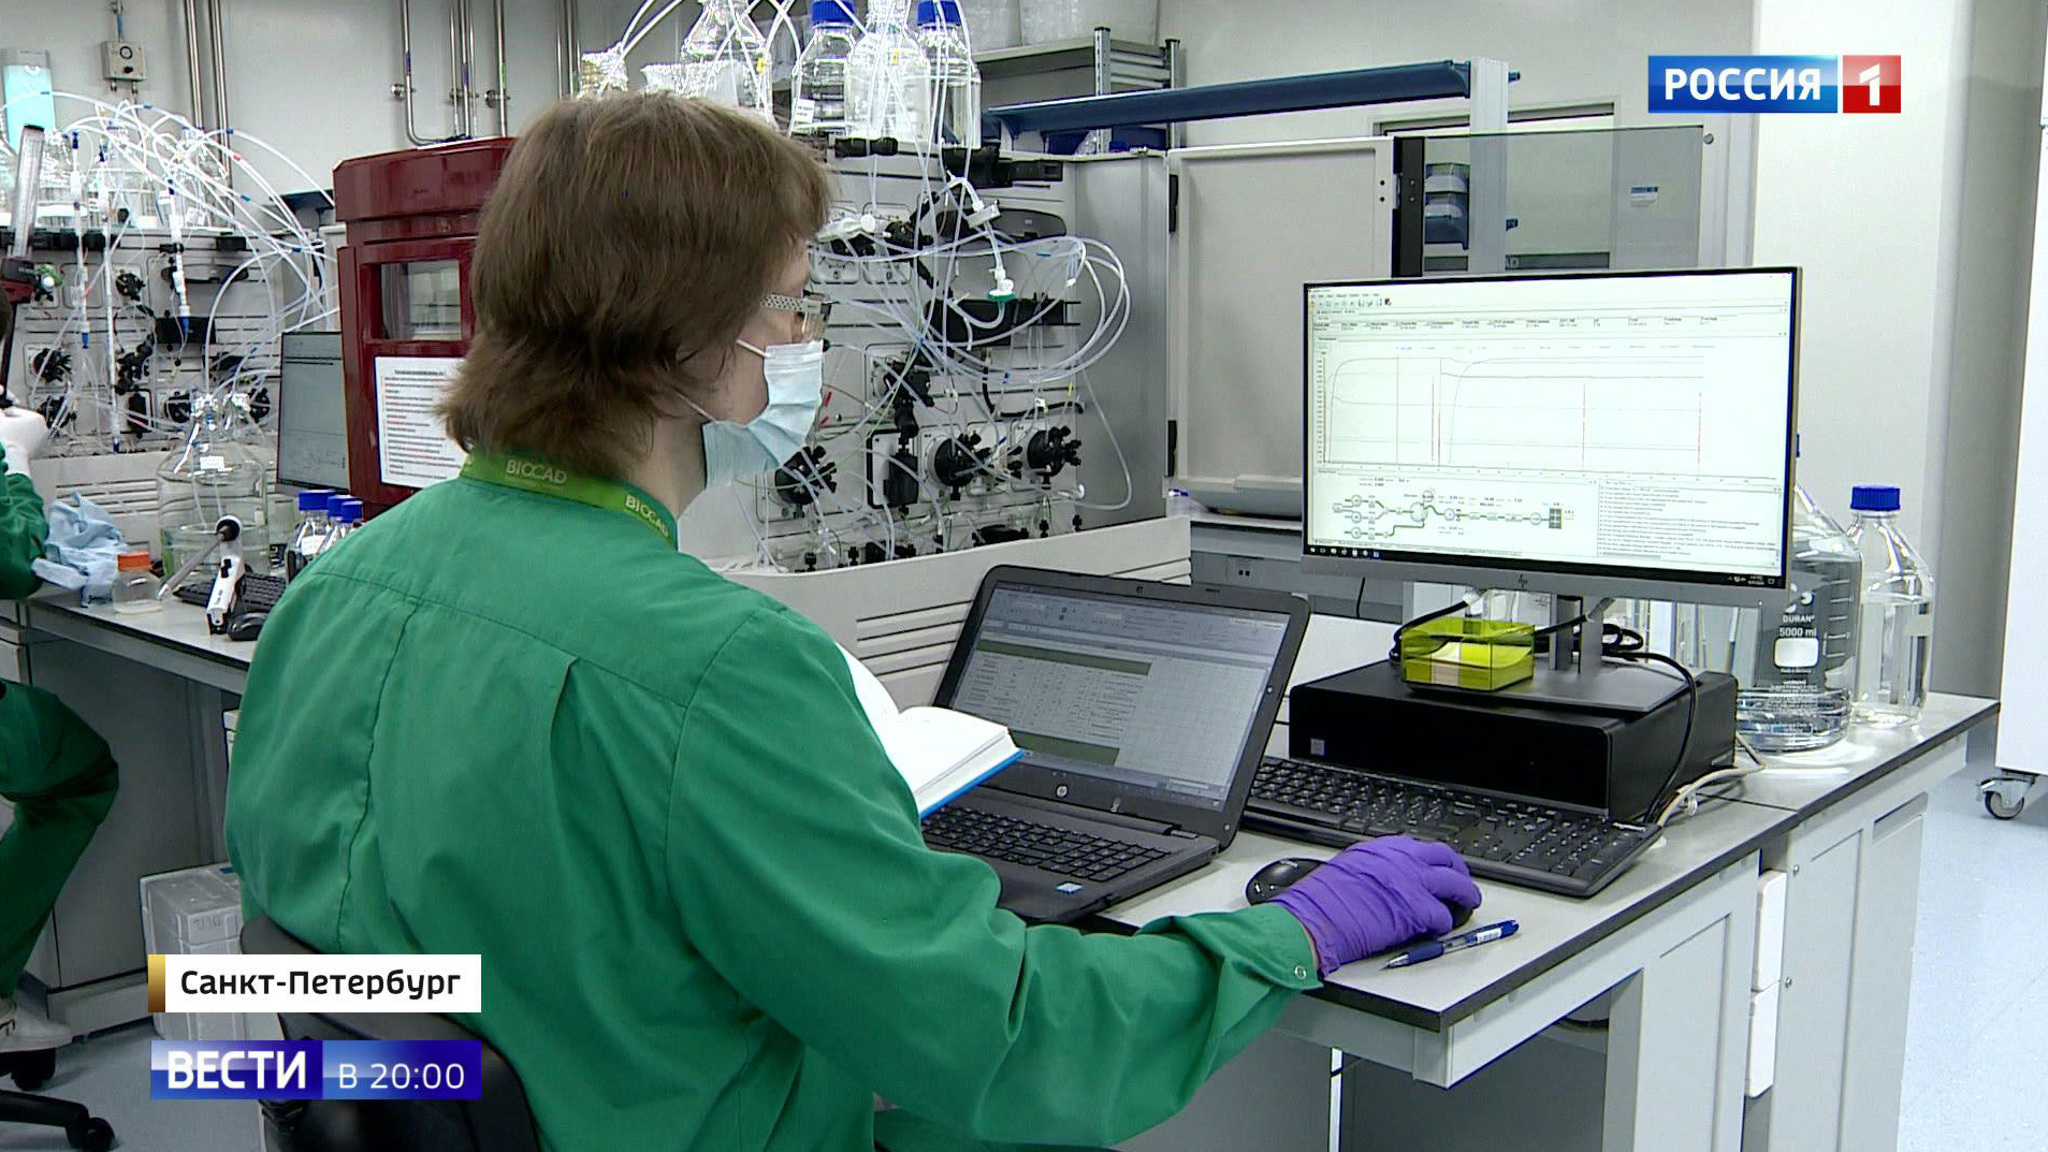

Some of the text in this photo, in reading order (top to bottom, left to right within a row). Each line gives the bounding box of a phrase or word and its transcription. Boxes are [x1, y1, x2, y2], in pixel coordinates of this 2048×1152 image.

[506, 459, 567, 484] BIOCAD
[625, 494, 669, 537] BIOCAD
[1780, 627, 1817, 637] 5000 ml
